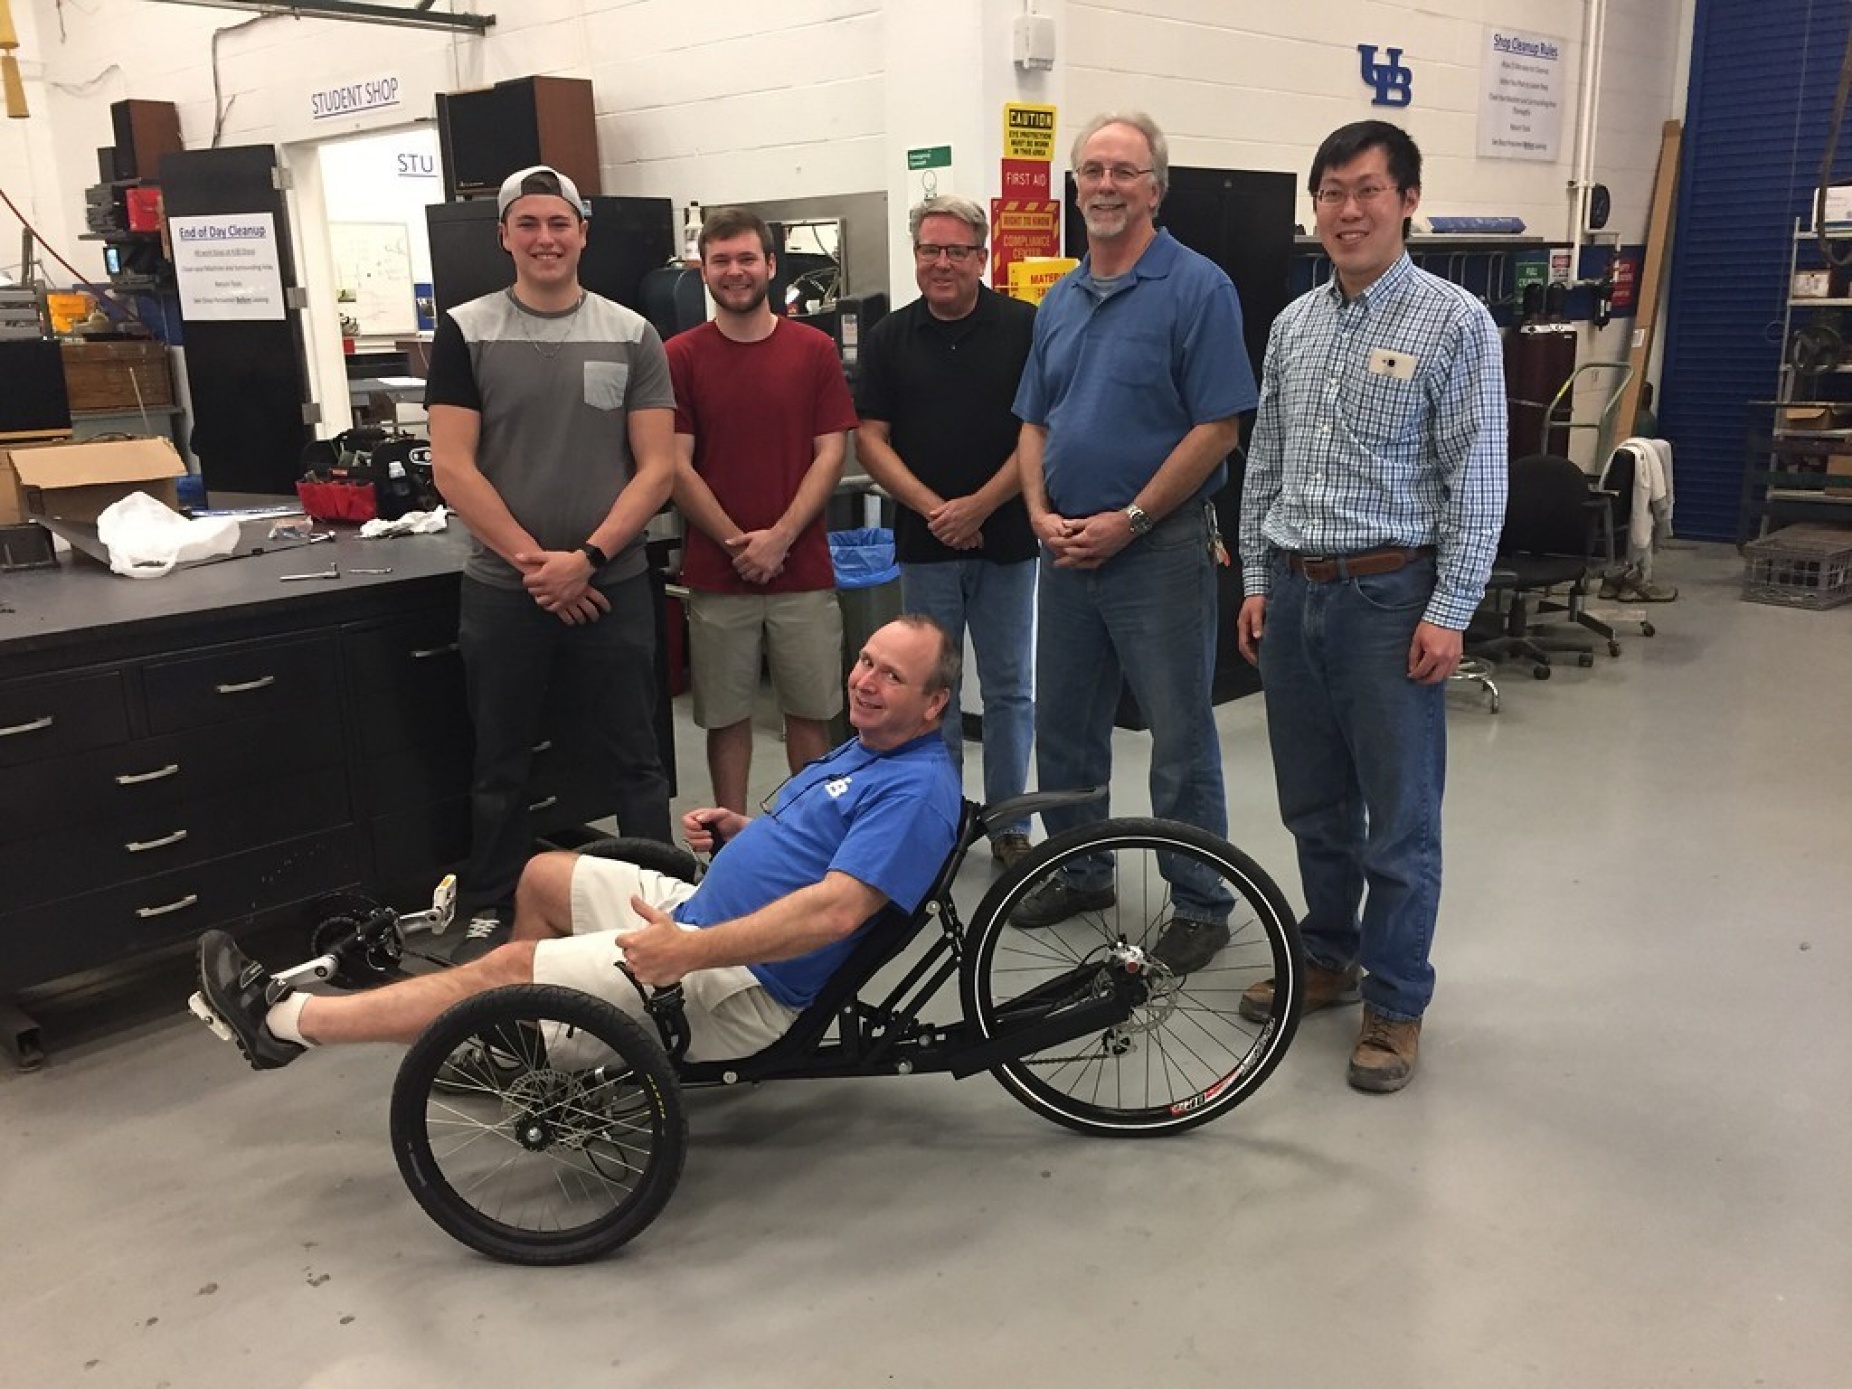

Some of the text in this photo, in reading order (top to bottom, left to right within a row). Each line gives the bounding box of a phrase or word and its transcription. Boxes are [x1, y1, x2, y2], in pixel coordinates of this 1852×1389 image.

[1493, 33, 1558, 57] Shop Cleanup Rules
[1357, 44, 1412, 106] UB
[312, 77, 398, 114] STUDENT SHOP
[1010, 112, 1052, 127] CAUTION
[1011, 139, 1026, 147] MUST
[1020, 131, 1052, 140] PROTECTION
[397, 153, 434, 173] STU
[1006, 172, 1047, 187] FIRST AID
[1003, 216, 1022, 227] RIGHT
[1023, 216, 1032, 227] TO
[179, 225, 266, 239] End of Day Cleanup
[1003, 234, 1050, 247] COMPLIANCE
